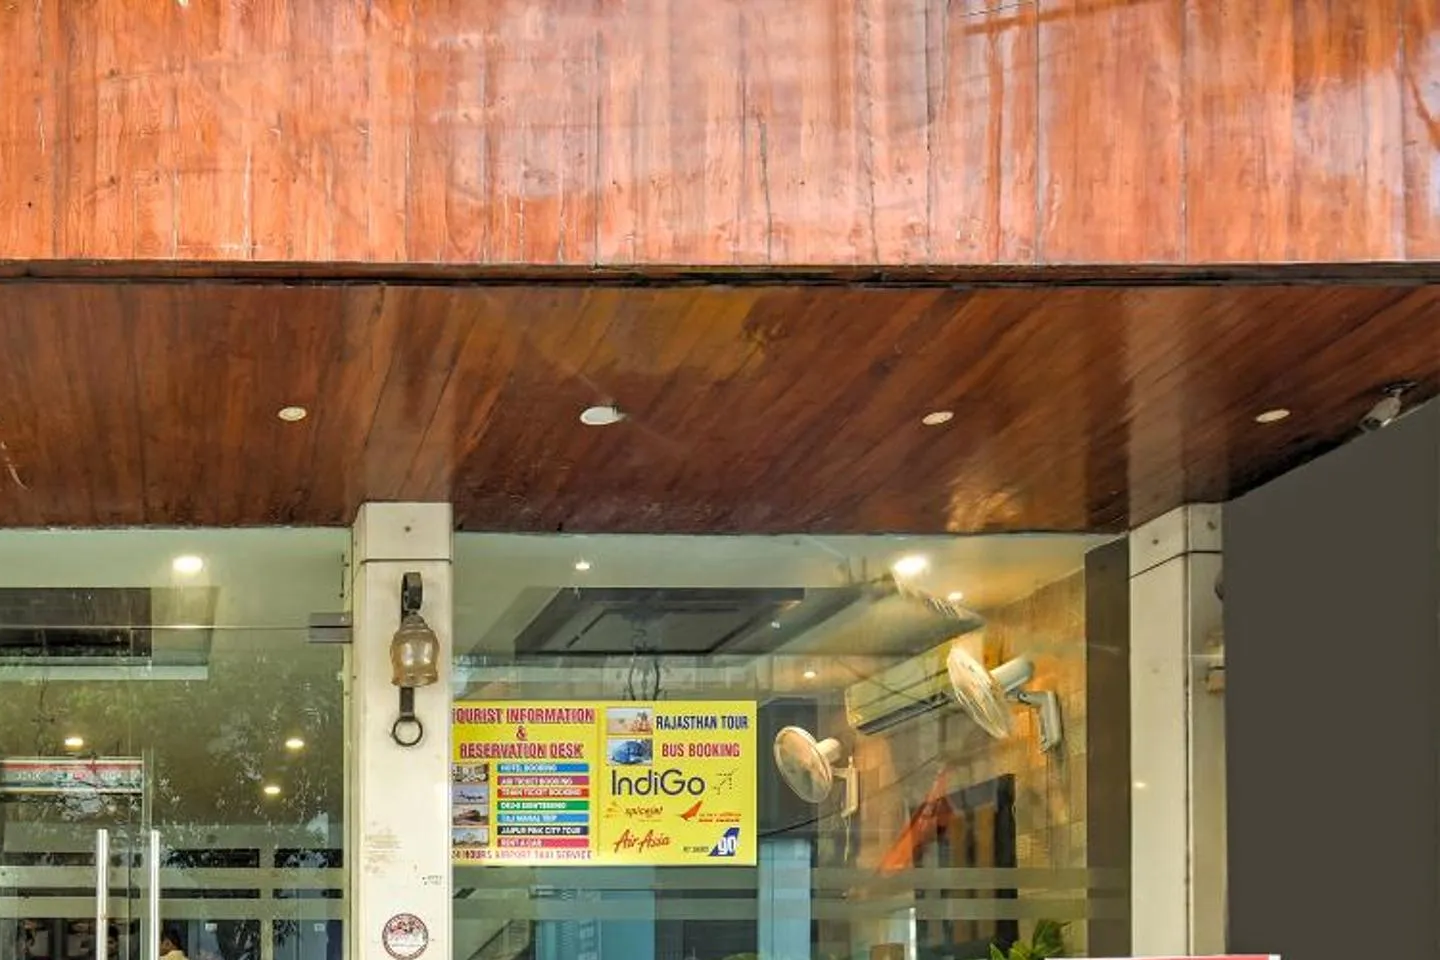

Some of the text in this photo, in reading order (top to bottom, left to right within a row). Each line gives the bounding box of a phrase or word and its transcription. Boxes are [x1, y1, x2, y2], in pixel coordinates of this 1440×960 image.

[506, 707, 595, 724] INFORMATION
[656, 715, 749, 731] RAJASTHAN TOUR
[516, 725, 527, 741] &
[460, 742, 584, 759] RESERVATION DESK
[662, 742, 740, 758] BUS BOOKING
[611, 769, 705, 796] IndiGo
